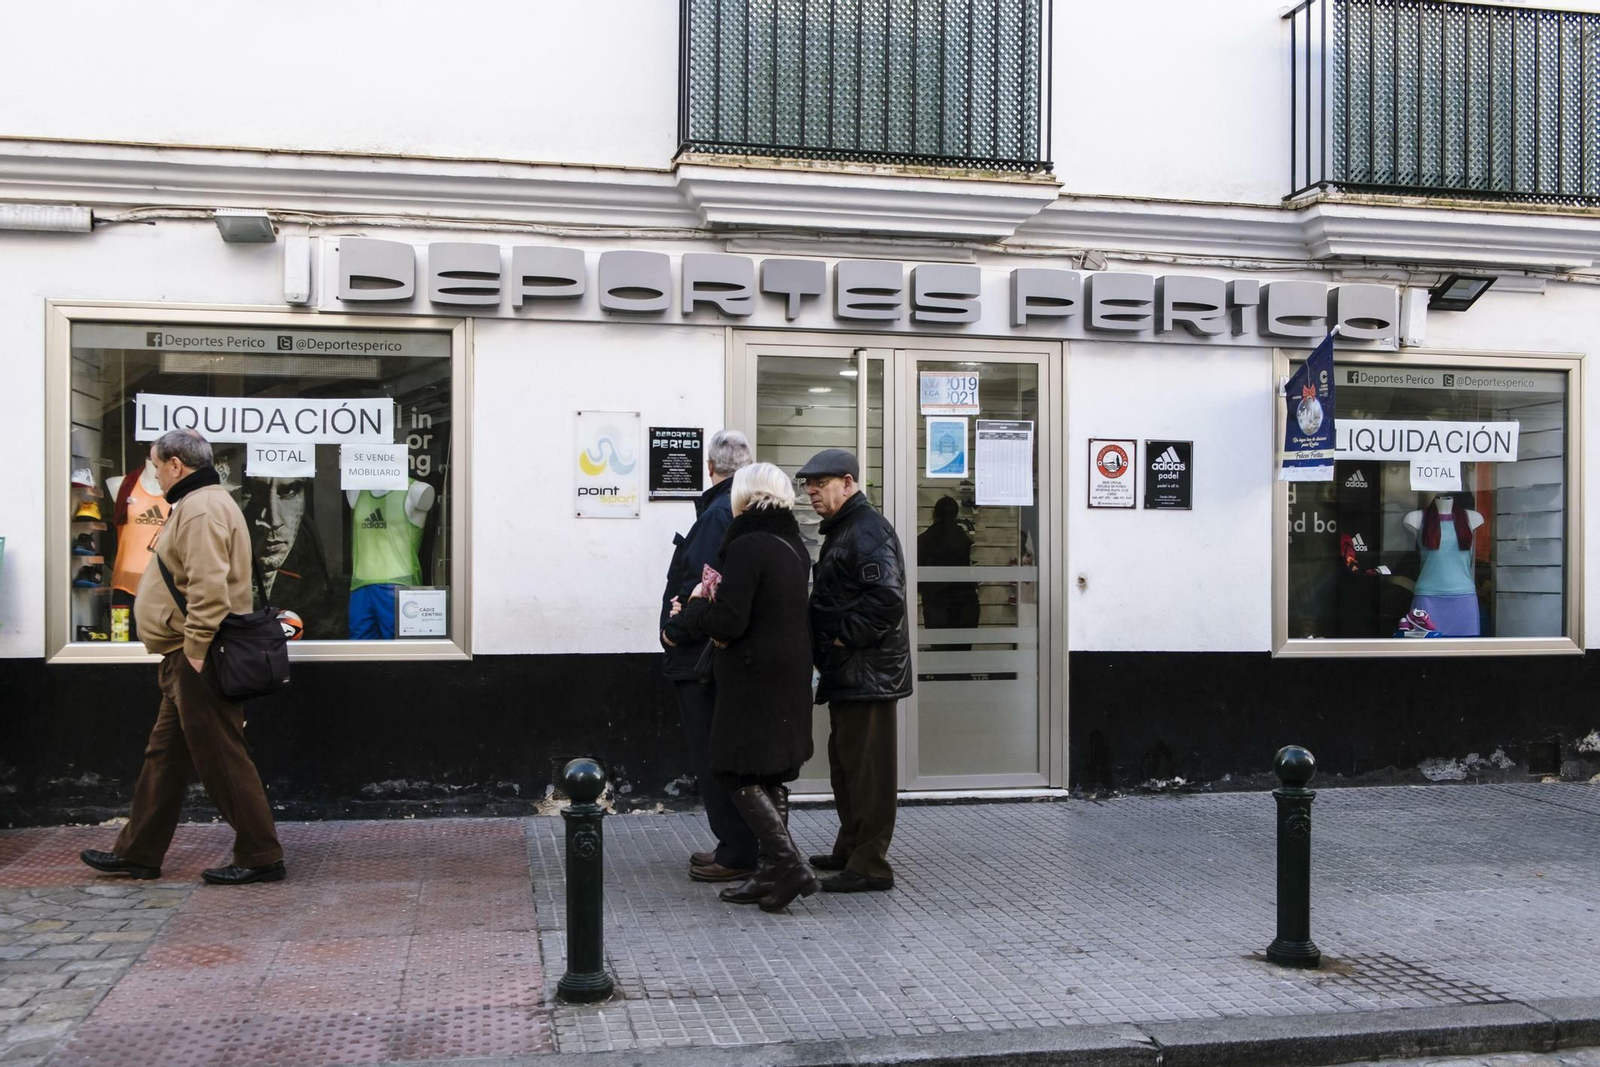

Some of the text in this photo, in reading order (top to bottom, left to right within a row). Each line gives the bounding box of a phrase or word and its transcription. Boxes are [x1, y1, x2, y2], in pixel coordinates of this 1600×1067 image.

[339, 238, 1396, 340] DEPORTES PERICO
[165, 334, 266, 348] Deportes Perico
[296, 338, 402, 353] @Deportesperico
[1360, 372, 1435, 385] Deportes Perico
[1456, 376, 1535, 389] @Deportesperico
[142, 402, 382, 435] LIQUIDACIÓN
[1334, 425, 1511, 454] LIQUIDACIÓN
[256, 449, 307, 463] TOTAL
[354, 453, 395, 462] SE VENDE
[1152, 461, 1186, 471] adidas
[348, 468, 401, 476] MOBILIARIO
[1158, 471, 1179, 481] padel
[1416, 467, 1455, 478] TOTAL
[1345, 480, 1369, 488] adidas
[578, 486, 620, 497] point
[599, 495, 637, 505] sport
[135, 517, 165, 527] adida
[1353, 543, 1368, 552] das
